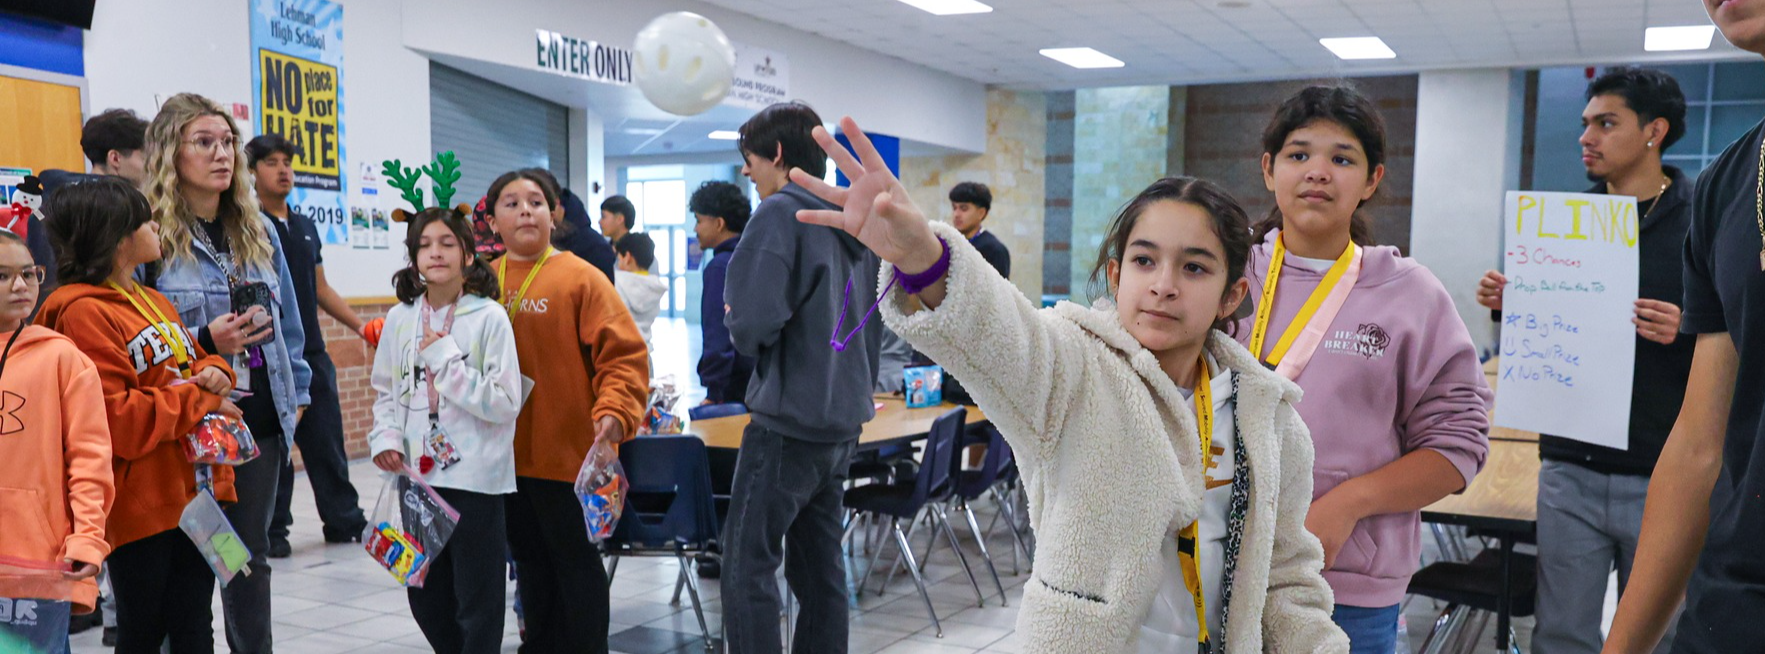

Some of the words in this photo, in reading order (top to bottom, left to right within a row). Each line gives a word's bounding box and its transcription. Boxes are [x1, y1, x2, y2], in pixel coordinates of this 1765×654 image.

[280, 2, 316, 28] Lehman
[271, 20, 293, 46] High
[295, 26, 326, 51] School
[537, 34, 590, 76] ENTER
[595, 44, 633, 83] ONLY
[265, 56, 303, 115] NO
[305, 67, 333, 95] place
[307, 97, 334, 117] for
[1516, 194, 1640, 249] PLINKO
[1525, 313, 1549, 338] Big
[127, 321, 198, 376] TEXA
[1518, 365, 1540, 381] No
